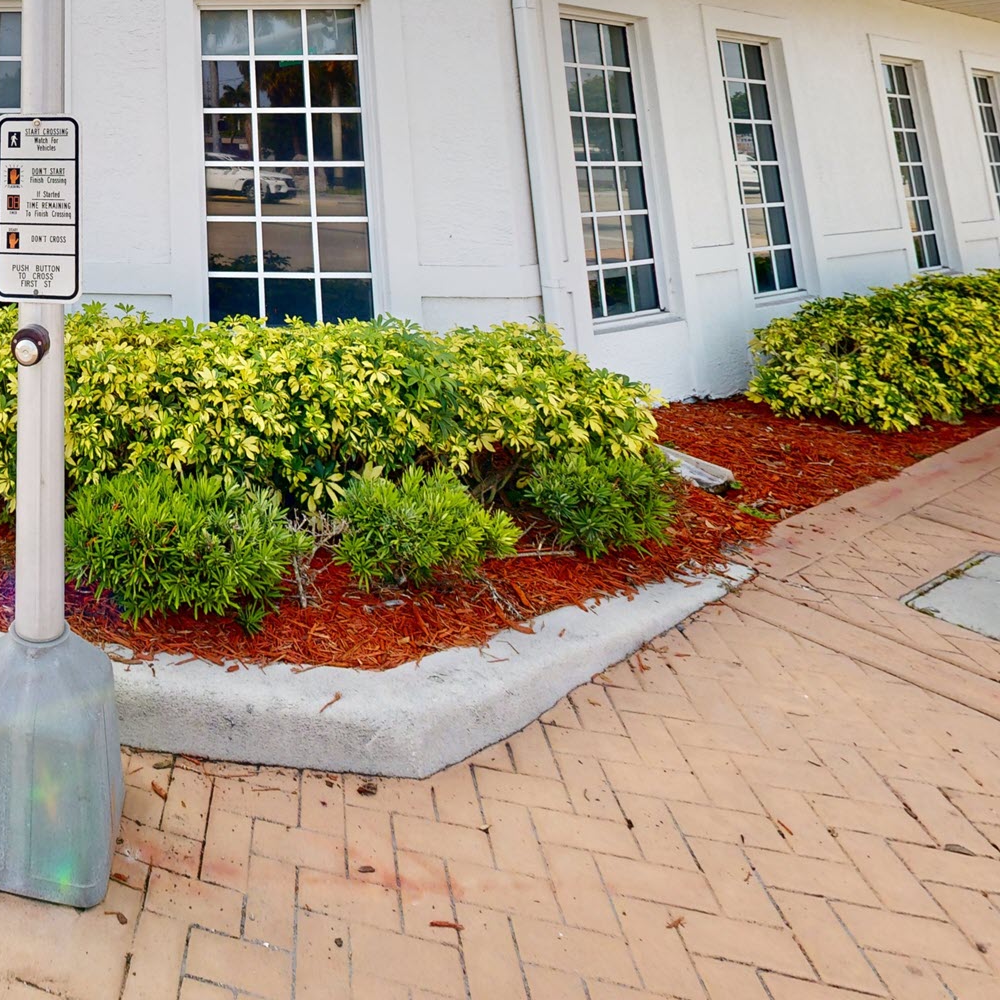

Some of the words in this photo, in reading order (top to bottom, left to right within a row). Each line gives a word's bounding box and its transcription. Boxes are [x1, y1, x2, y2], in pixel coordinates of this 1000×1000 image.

[25, 128, 40, 136] START
[43, 128, 69, 136] CROSSING
[47, 177, 67, 186] Crossing
[42, 202, 71, 210] REMAINING
[52, 211, 72, 220] Crossing
[31, 235, 47, 243] DON'T
[12, 264, 30, 272] PUSH
[33, 272, 54, 280] CROSS
[44, 280, 51, 288] ST
